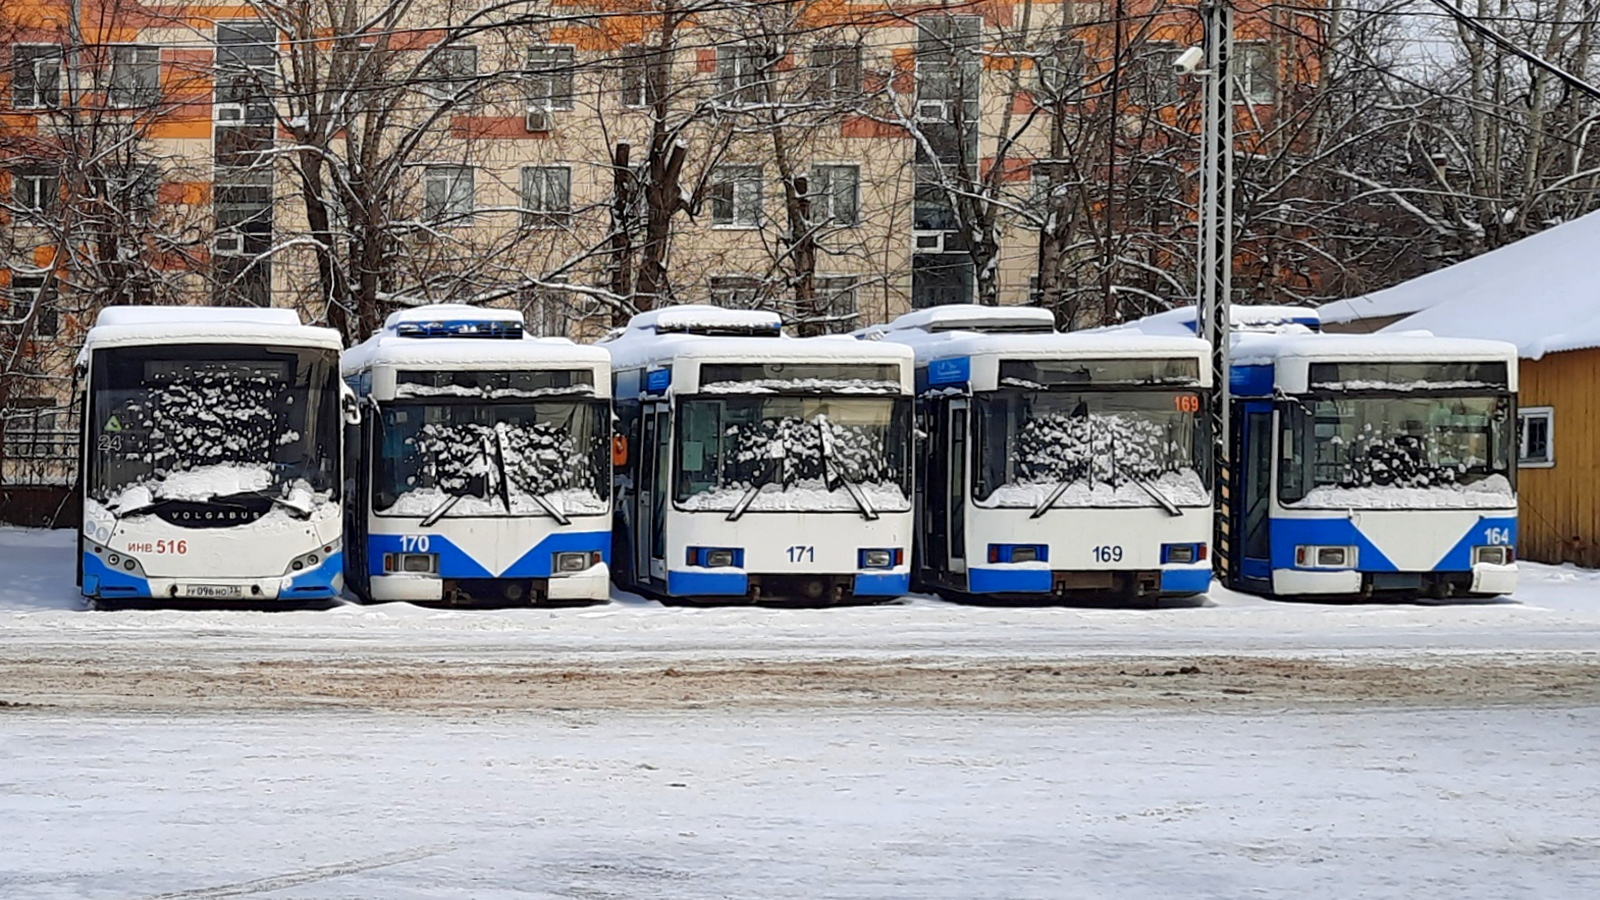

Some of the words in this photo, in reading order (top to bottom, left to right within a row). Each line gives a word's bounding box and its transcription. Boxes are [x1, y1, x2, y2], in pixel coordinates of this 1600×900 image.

[1174, 396, 1199, 412] 169
[98, 434, 122, 451] 24
[171, 511, 260, 520] VOLGABUS
[399, 535, 430, 552] 170
[1484, 527, 1509, 545] 164
[156, 539, 187, 555] 516
[786, 545, 814, 563] 171
[1092, 545, 1123, 563] 169
